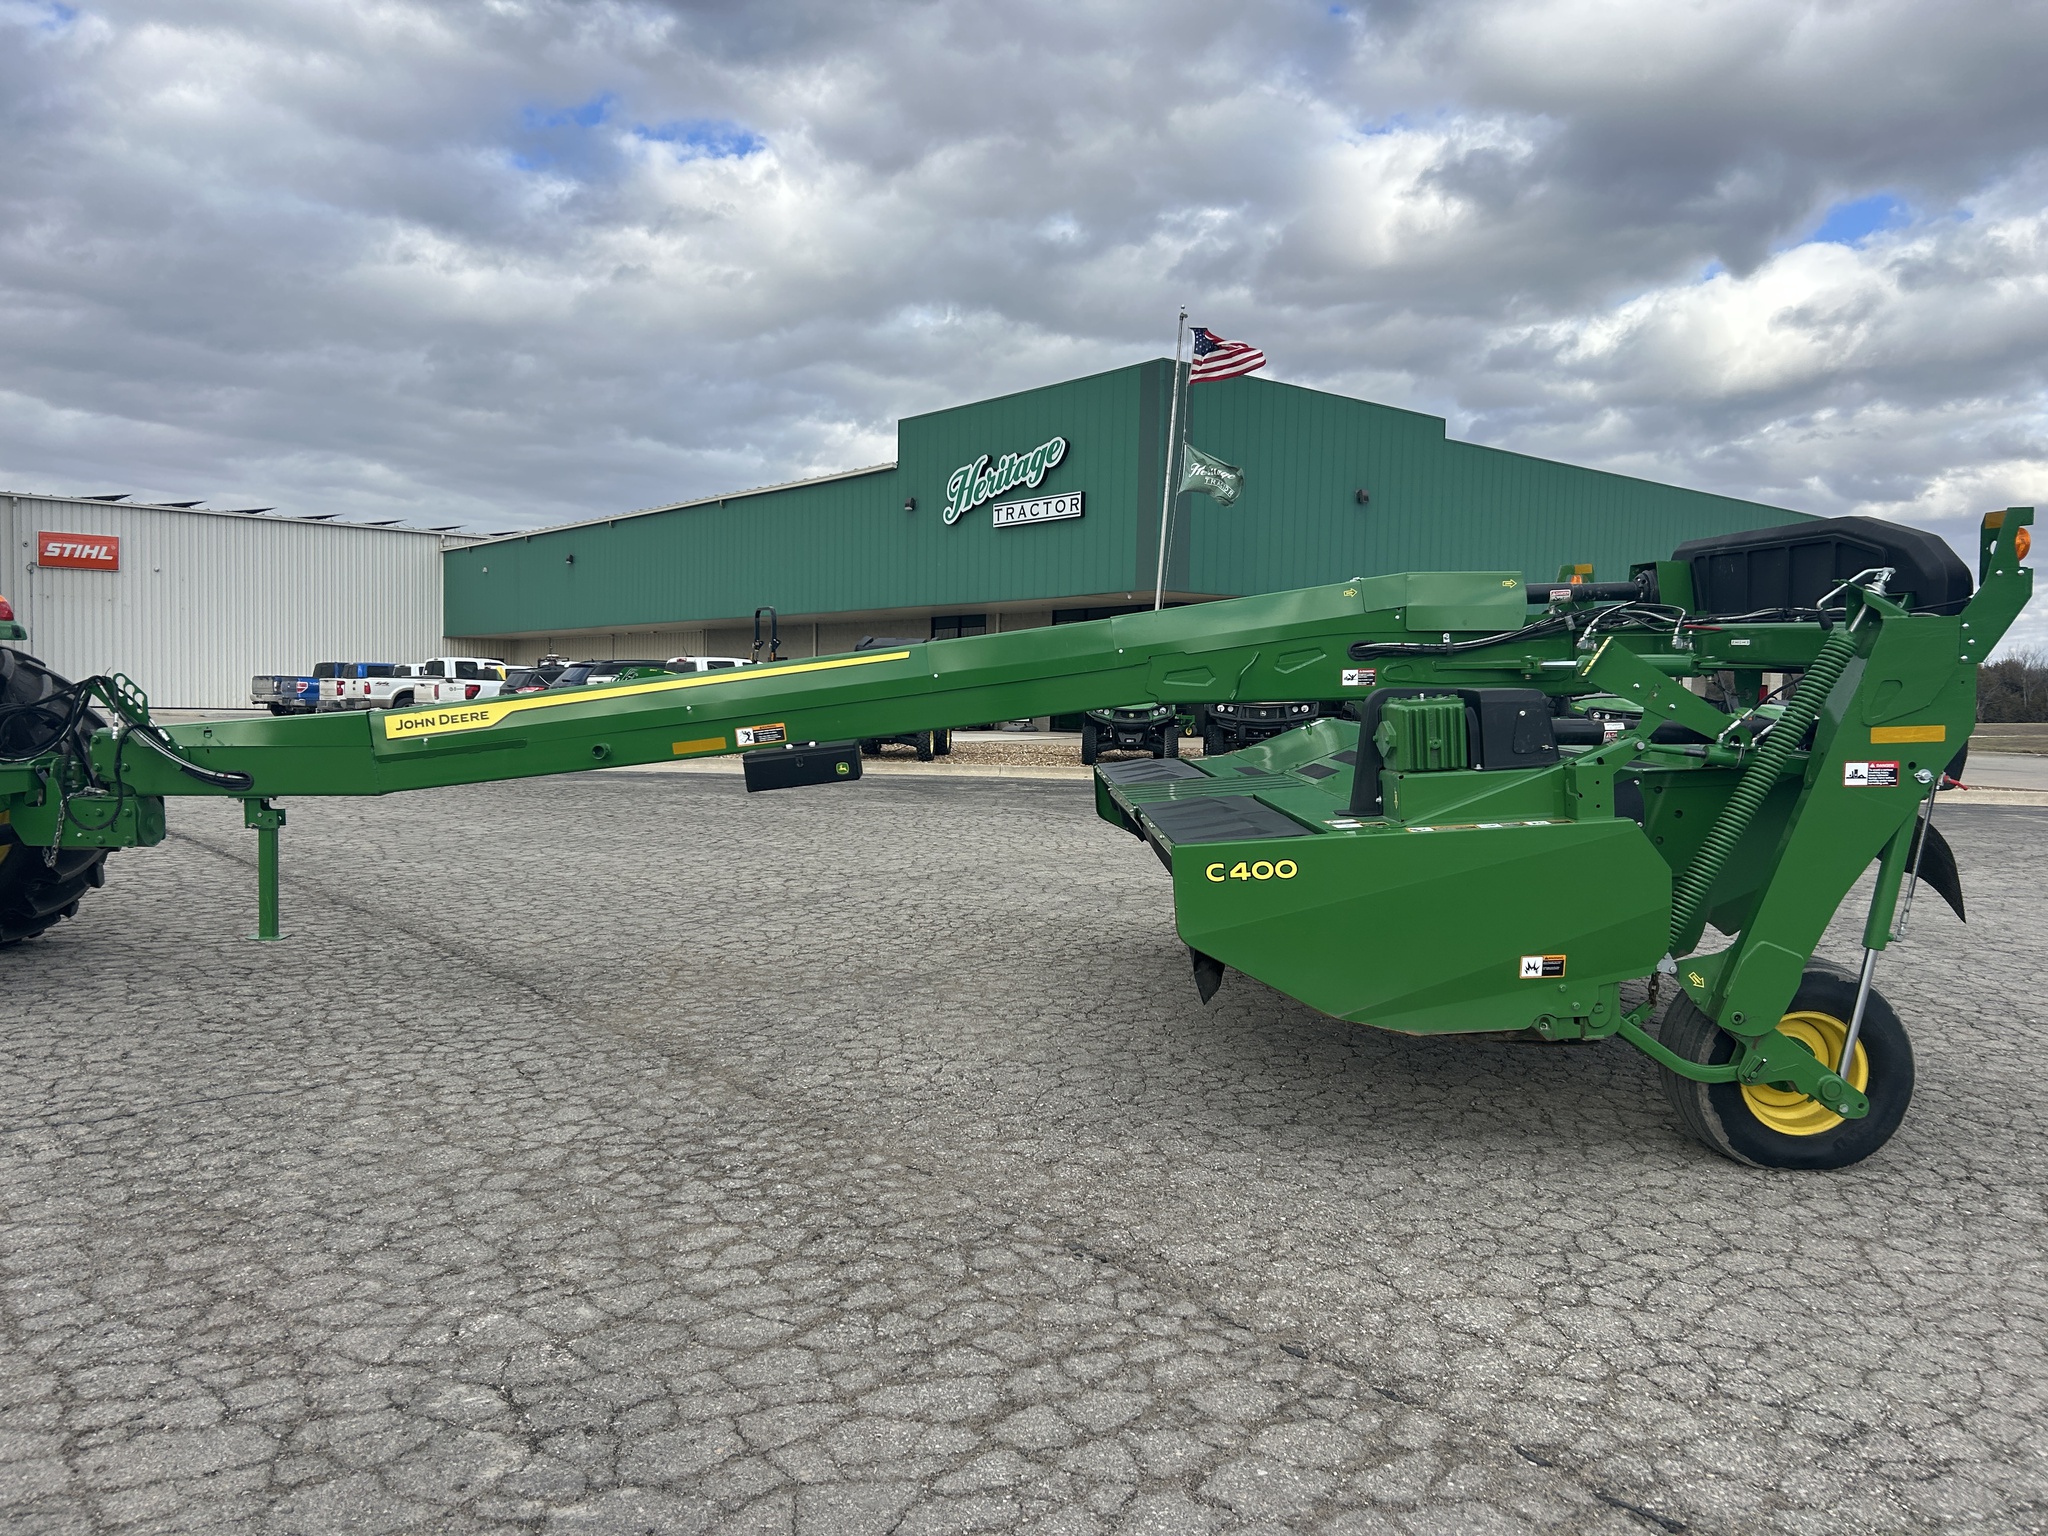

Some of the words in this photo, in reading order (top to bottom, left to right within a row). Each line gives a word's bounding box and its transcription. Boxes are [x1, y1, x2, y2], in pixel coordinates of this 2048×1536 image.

[943, 437, 1065, 524] Heritage
[994, 497, 1080, 522] TRACTOR
[44, 542, 113, 560] STIHL
[395, 717, 435, 731] JOHN
[439, 711, 490, 726] DEERE
